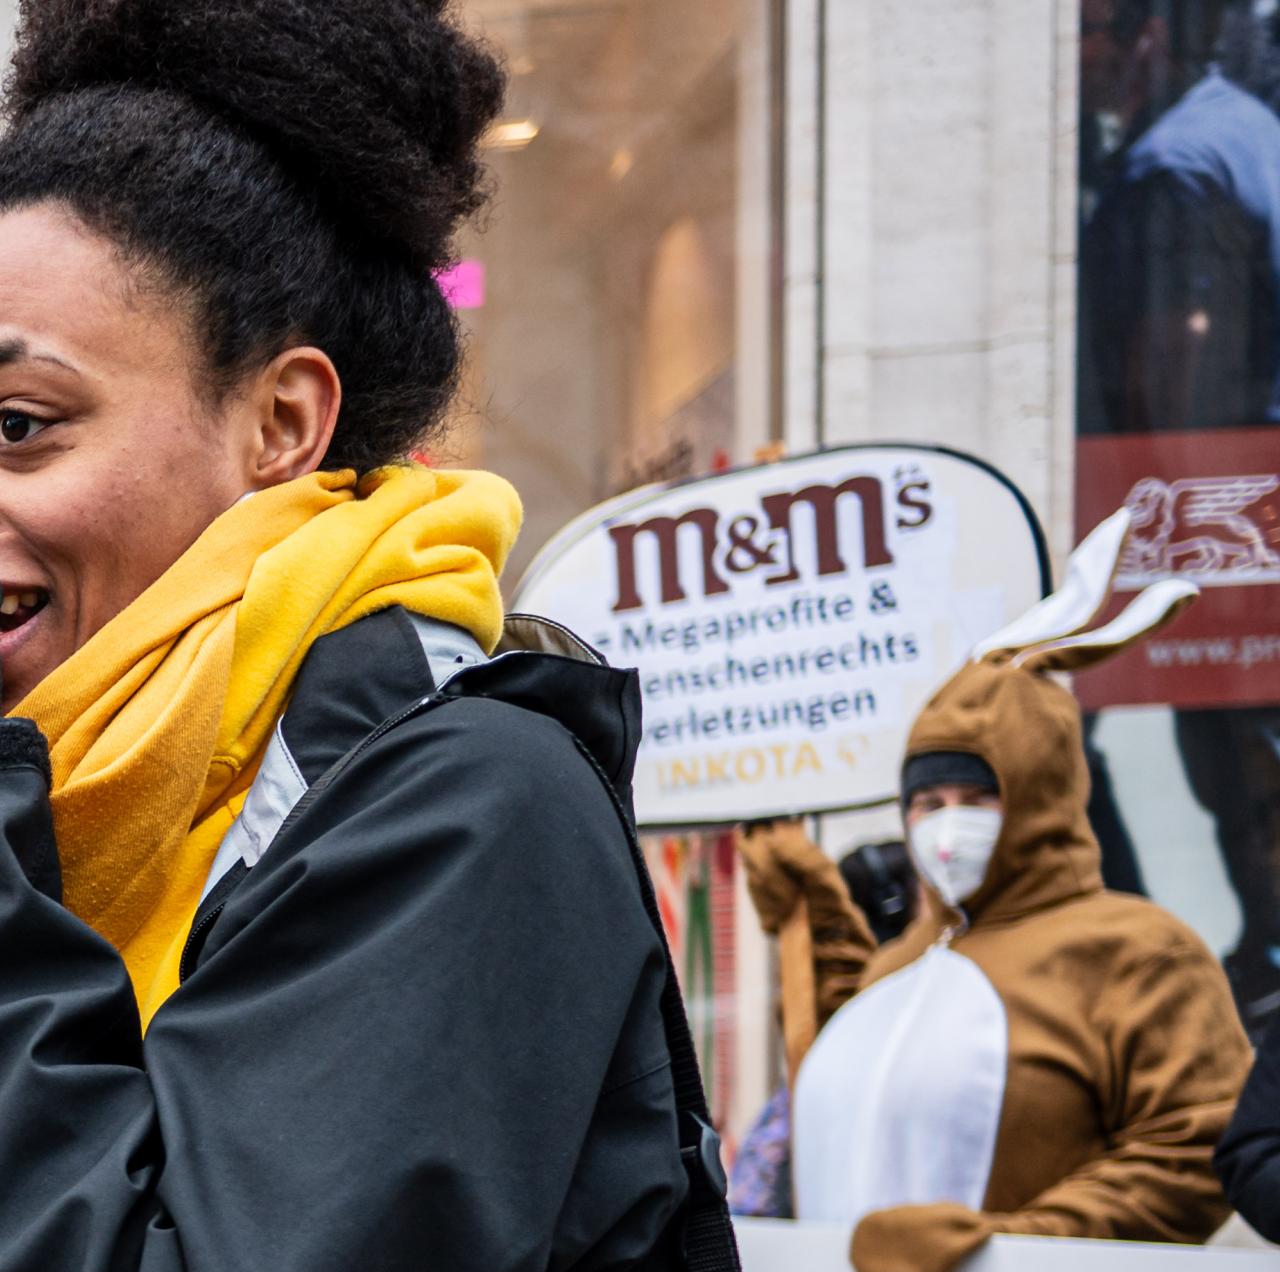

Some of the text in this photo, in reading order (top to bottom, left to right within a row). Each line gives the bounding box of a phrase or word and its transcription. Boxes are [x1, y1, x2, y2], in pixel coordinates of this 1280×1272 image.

[622, 596, 854, 650] Megaprofite
[869, 581, 899, 616] &
[643, 632, 920, 698] enschenrechts
[643, 687, 878, 747] erletzungen
[657, 740, 823, 790] INKOTA
